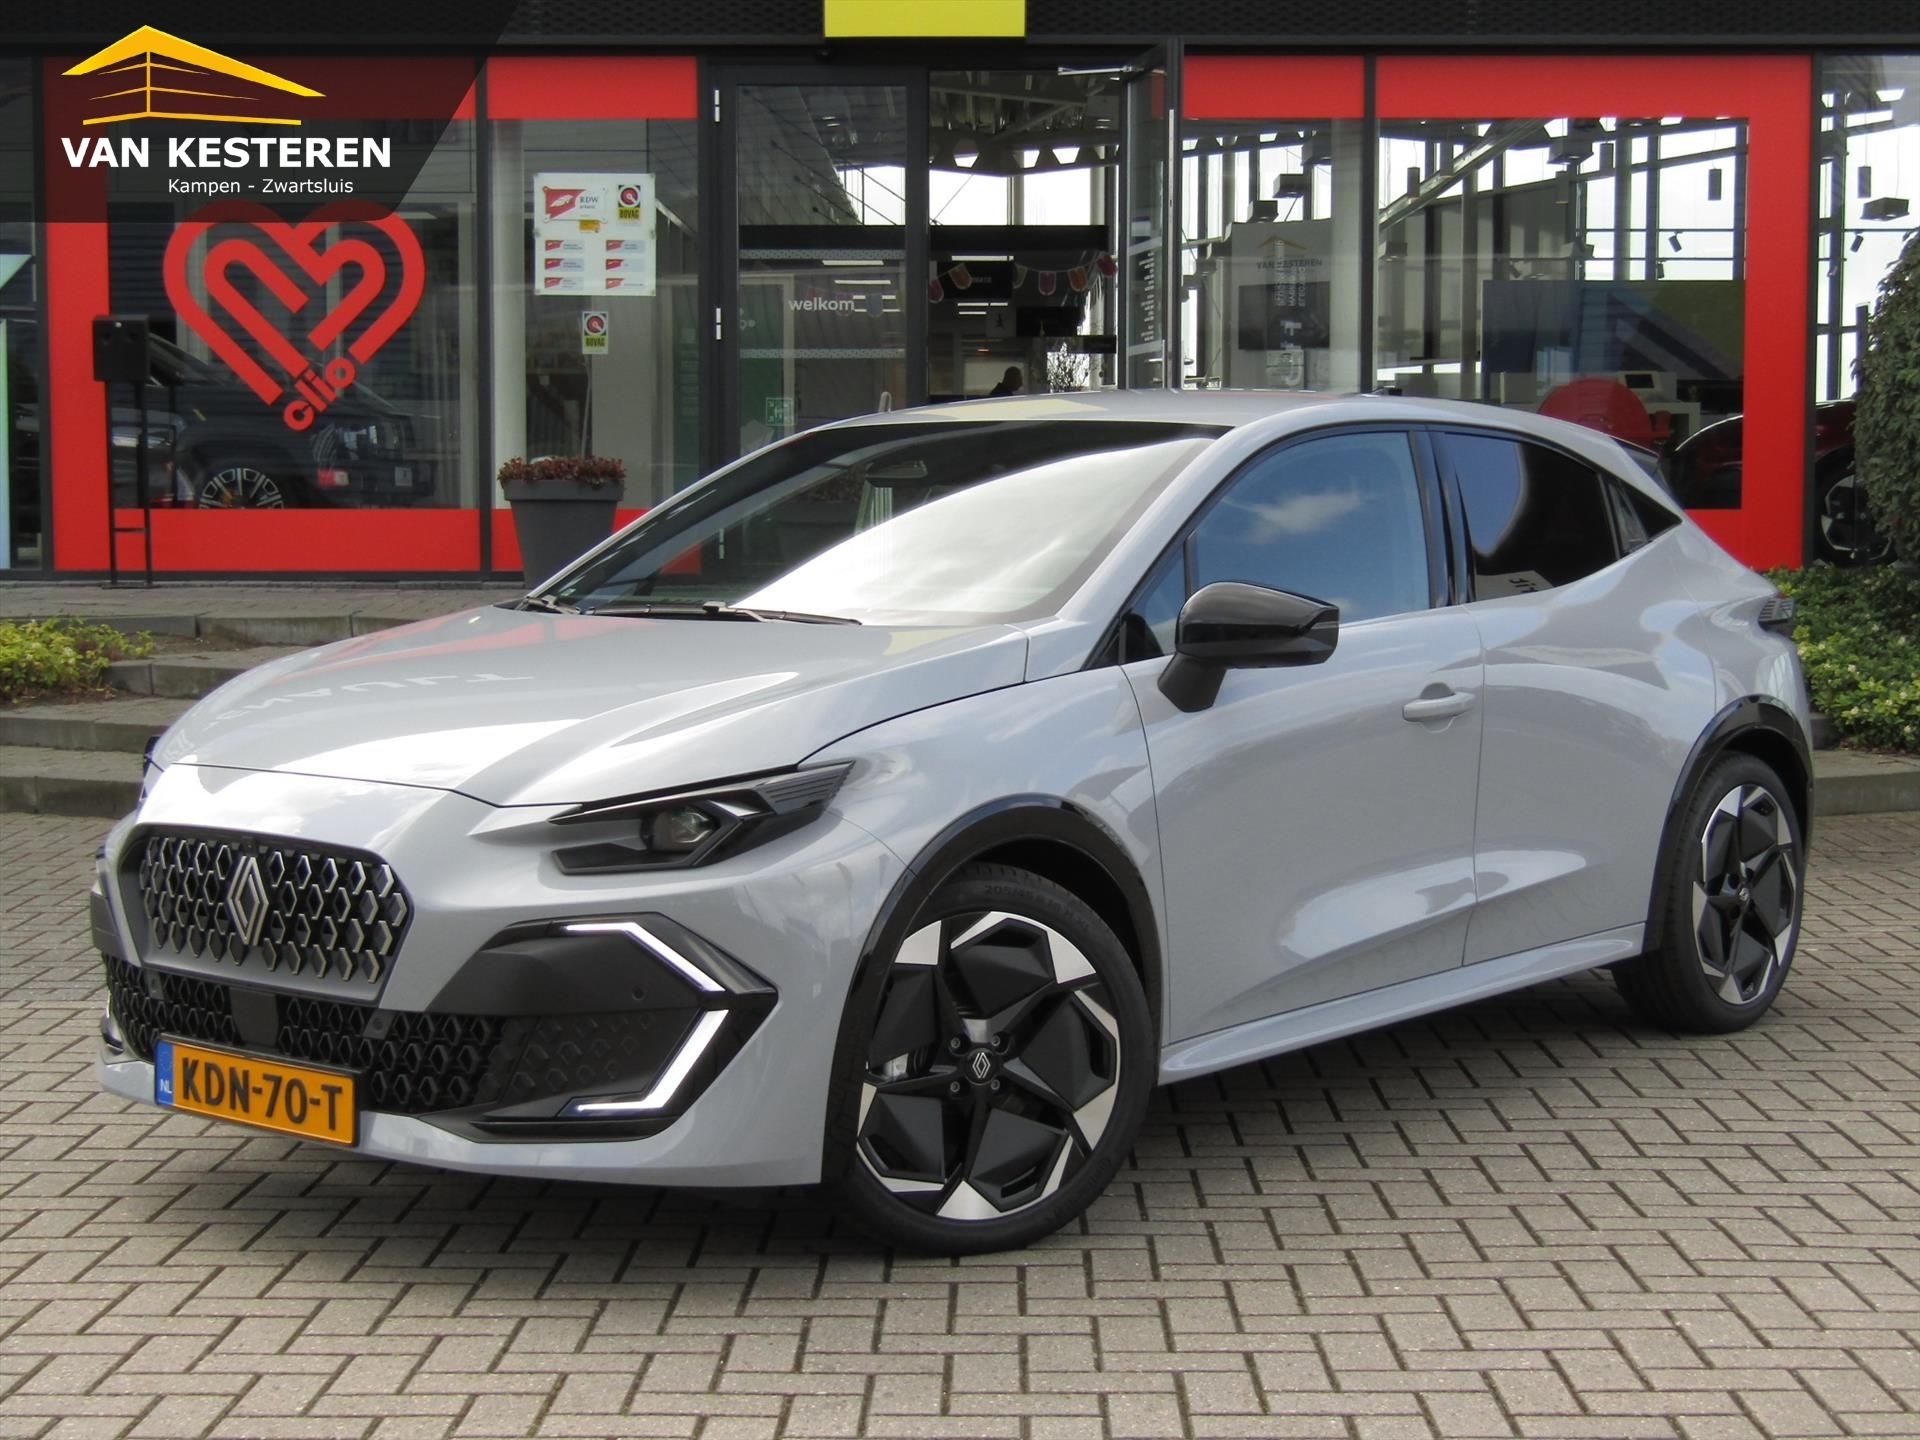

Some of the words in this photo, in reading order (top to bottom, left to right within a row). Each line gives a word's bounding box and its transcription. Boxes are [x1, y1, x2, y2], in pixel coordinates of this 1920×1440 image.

[788, 297, 855, 311] welkom
[284, 357, 356, 431] clio
[160, 1079, 172, 1094] NL
[182, 1057, 343, 1131] KDN-70-T
